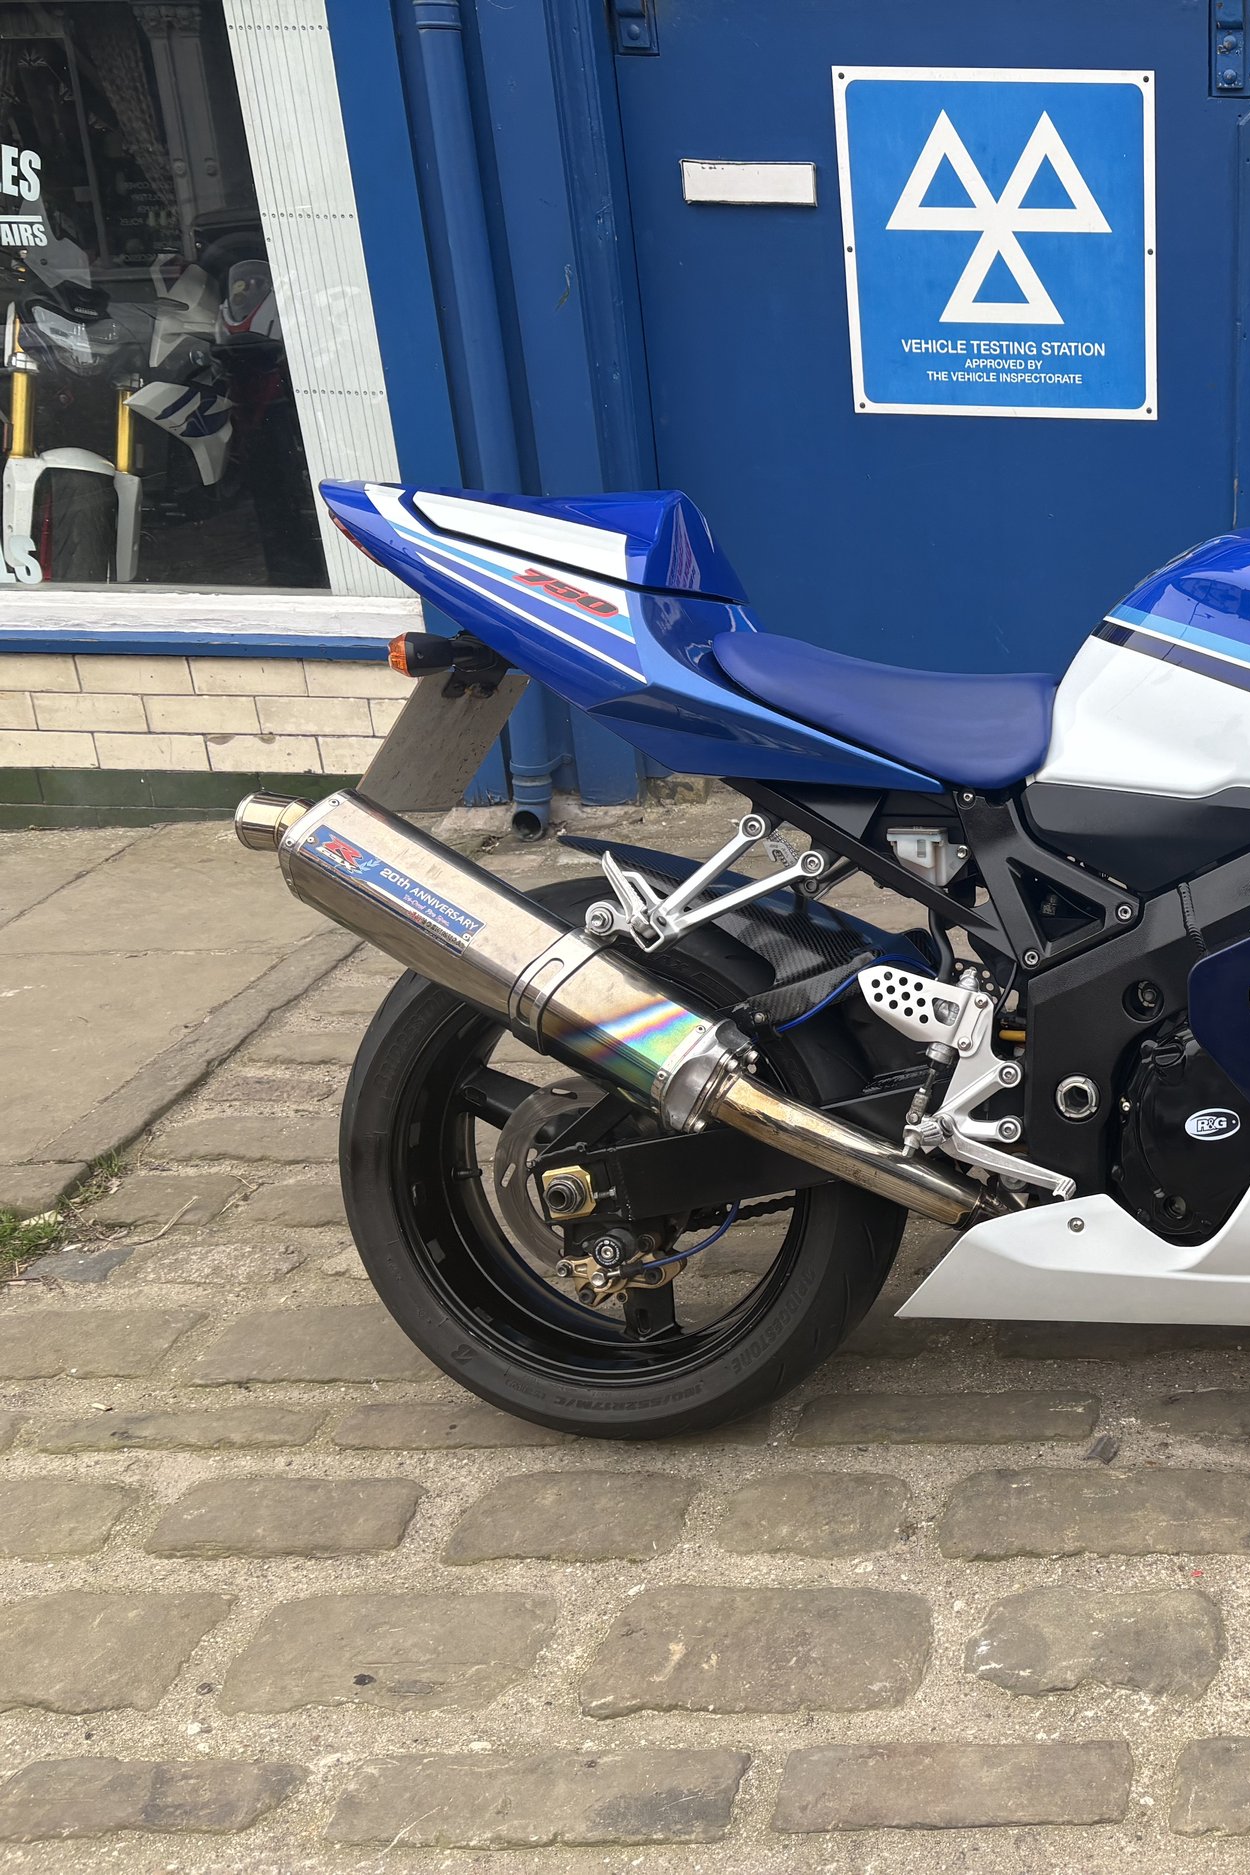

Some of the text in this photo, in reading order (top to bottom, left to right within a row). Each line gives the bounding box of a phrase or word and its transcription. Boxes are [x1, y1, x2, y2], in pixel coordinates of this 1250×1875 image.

[0, 143, 41, 202] ES
[901, 339, 1105, 357] VEHICLE TESTING STATION
[964, 358, 1043, 370] APPROVED BY
[926, 370, 1083, 384] THE VEHICLE INSPECTORATE
[513, 568, 619, 618] 750
[379, 867, 479, 930] 20th ANNIVERSARY
[1197, 1116, 1227, 1132] R&G
